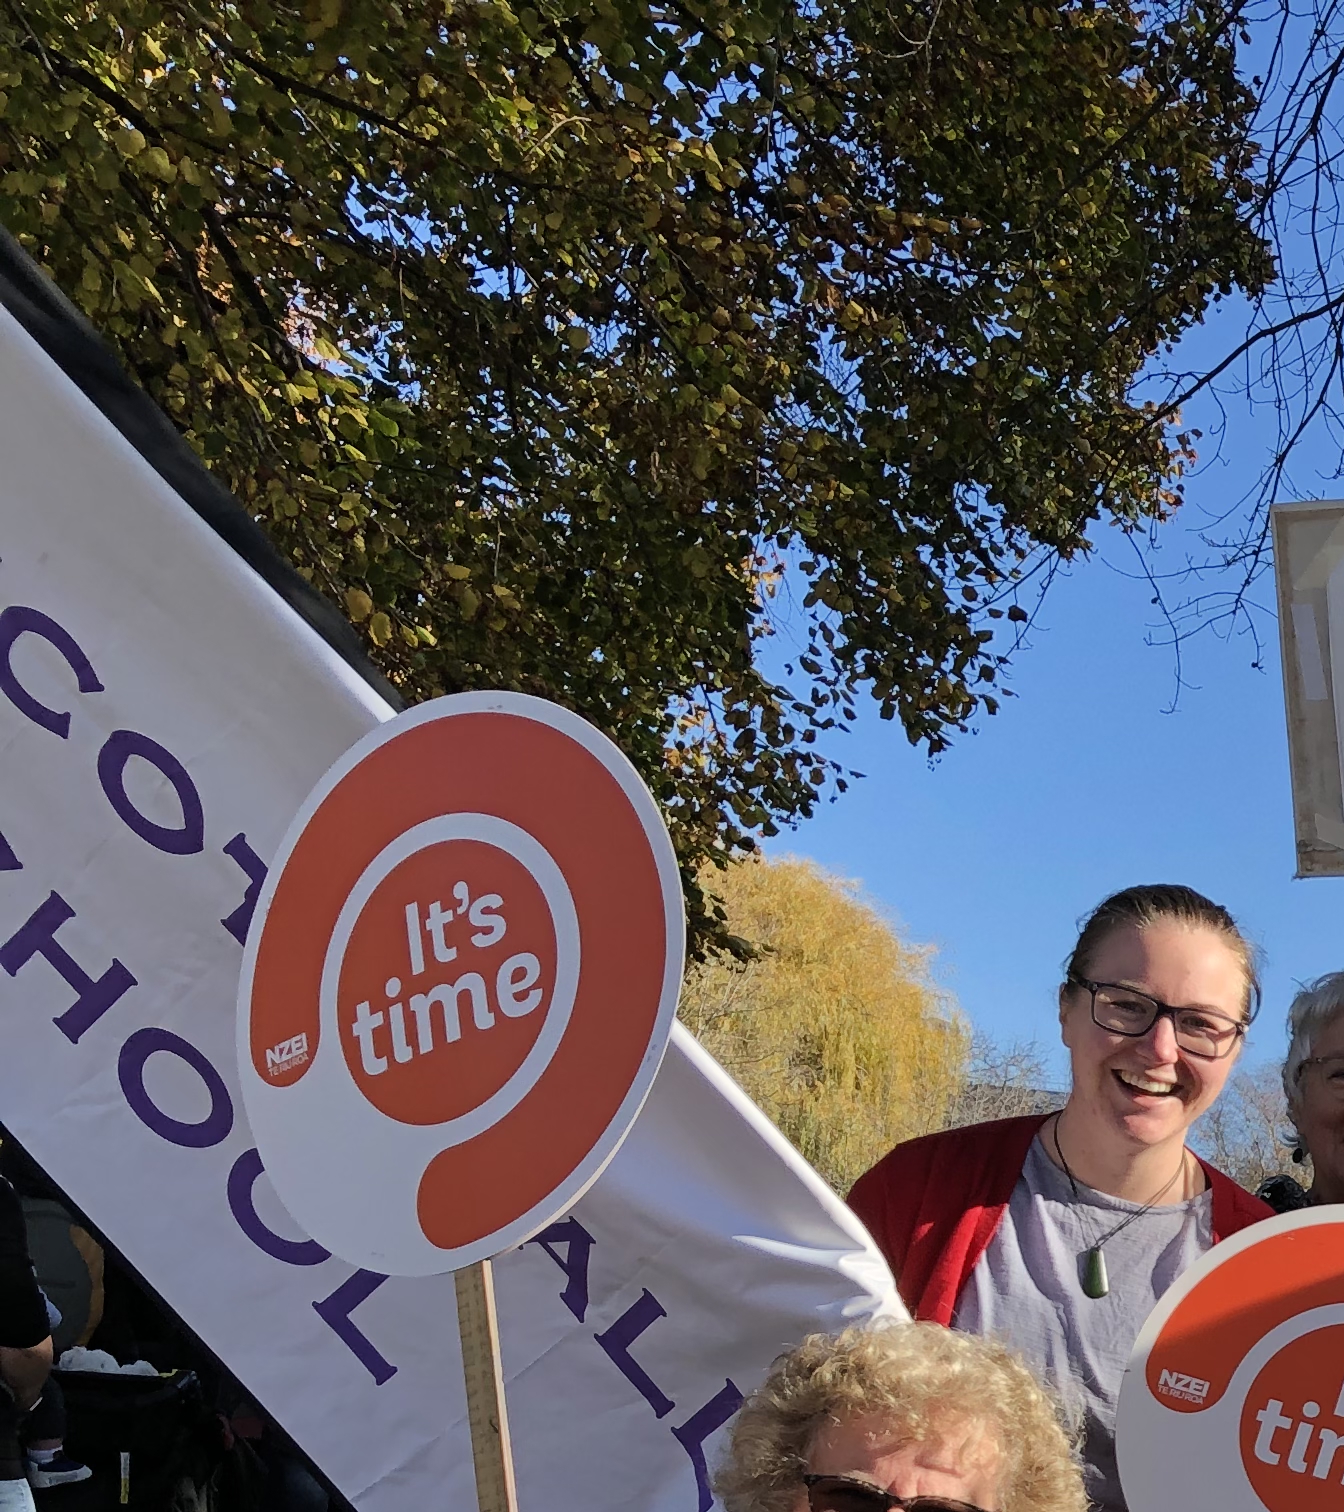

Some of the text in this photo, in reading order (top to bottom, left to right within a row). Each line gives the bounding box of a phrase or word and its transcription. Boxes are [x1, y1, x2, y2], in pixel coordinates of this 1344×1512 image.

[404, 881, 507, 975] It's
[352, 951, 544, 1076] time
[266, 1032, 308, 1068] NZEI
[1159, 1368, 1210, 1397] NZEI
